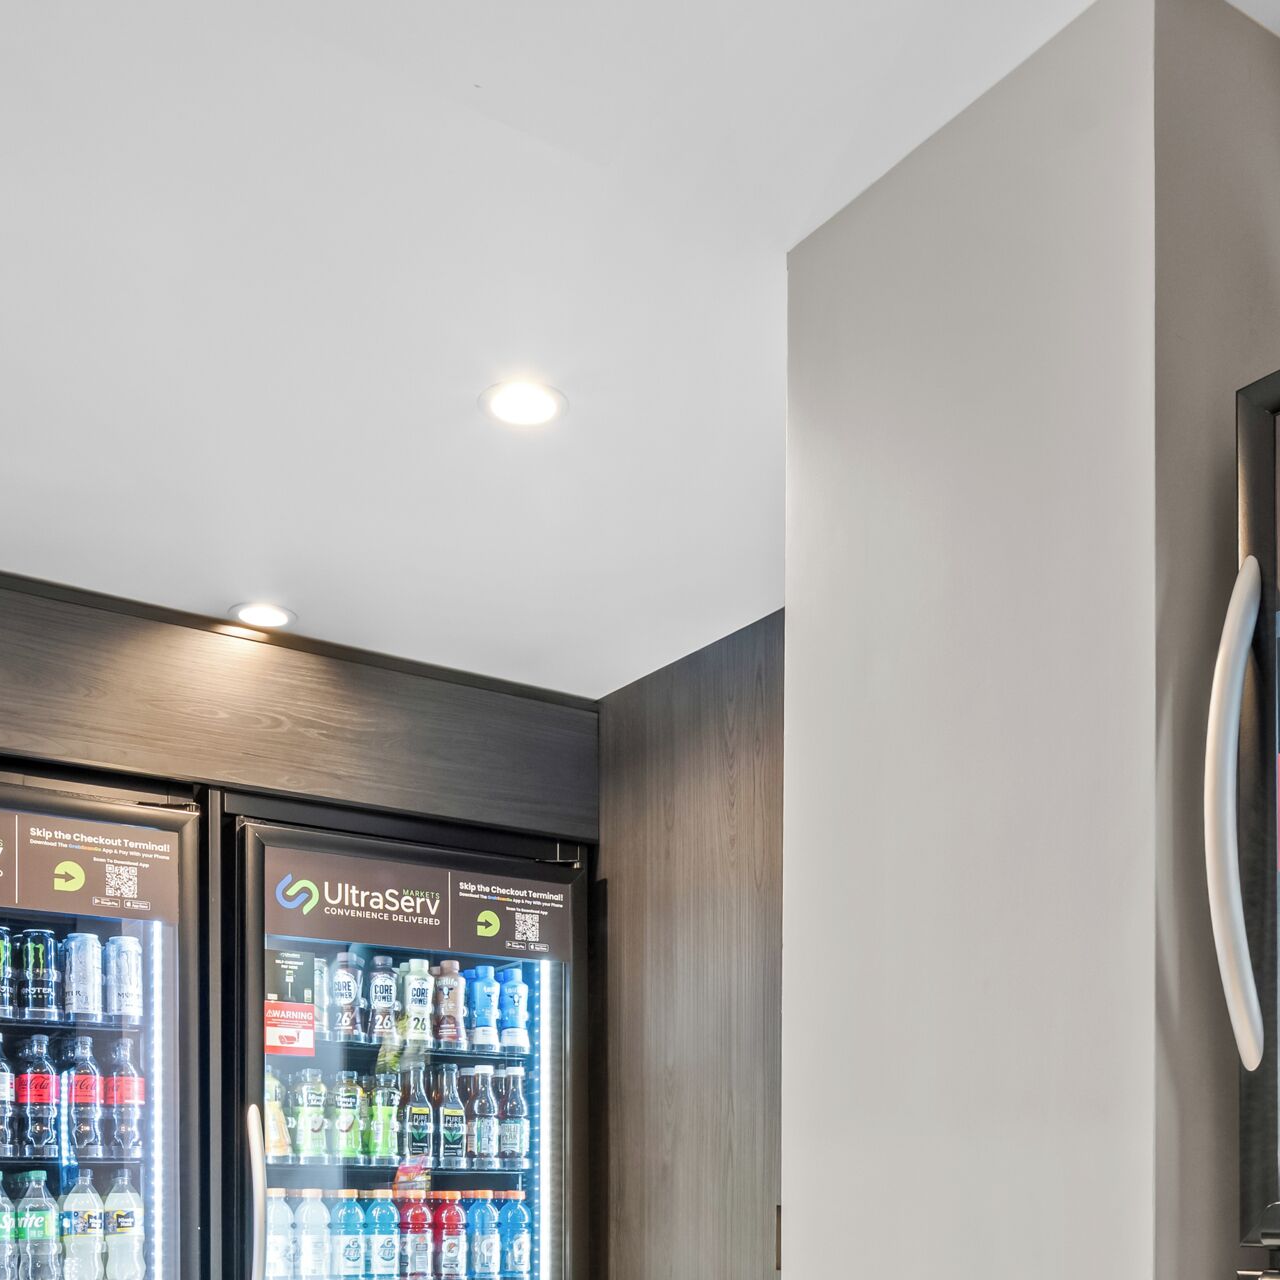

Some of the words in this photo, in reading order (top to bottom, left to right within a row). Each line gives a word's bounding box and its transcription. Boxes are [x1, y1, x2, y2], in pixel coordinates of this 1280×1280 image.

[29, 827, 53, 840] Skip
[54, 830, 72, 841] the
[73, 832, 122, 847] Checkout
[123, 839, 170, 853] Terminal!
[324, 881, 440, 915] UltraServ
[402, 889, 440, 900] MARKETS
[459, 882, 476, 893] Skip
[477, 885, 490, 893] the
[491, 886, 527, 897] Checkout
[528, 890, 564, 901] Terminal!
[324, 906, 389, 920] CONVENIENCE
[392, 914, 440, 926] DELIVERED
[374, 984, 393, 995] CORE
[411, 988, 429, 998] CORE
[373, 994, 393, 1002] POWER
[272, 1010, 313, 1020] WARNING
[374, 1015, 391, 1029] 26
[413, 1017, 427, 1031] 26
